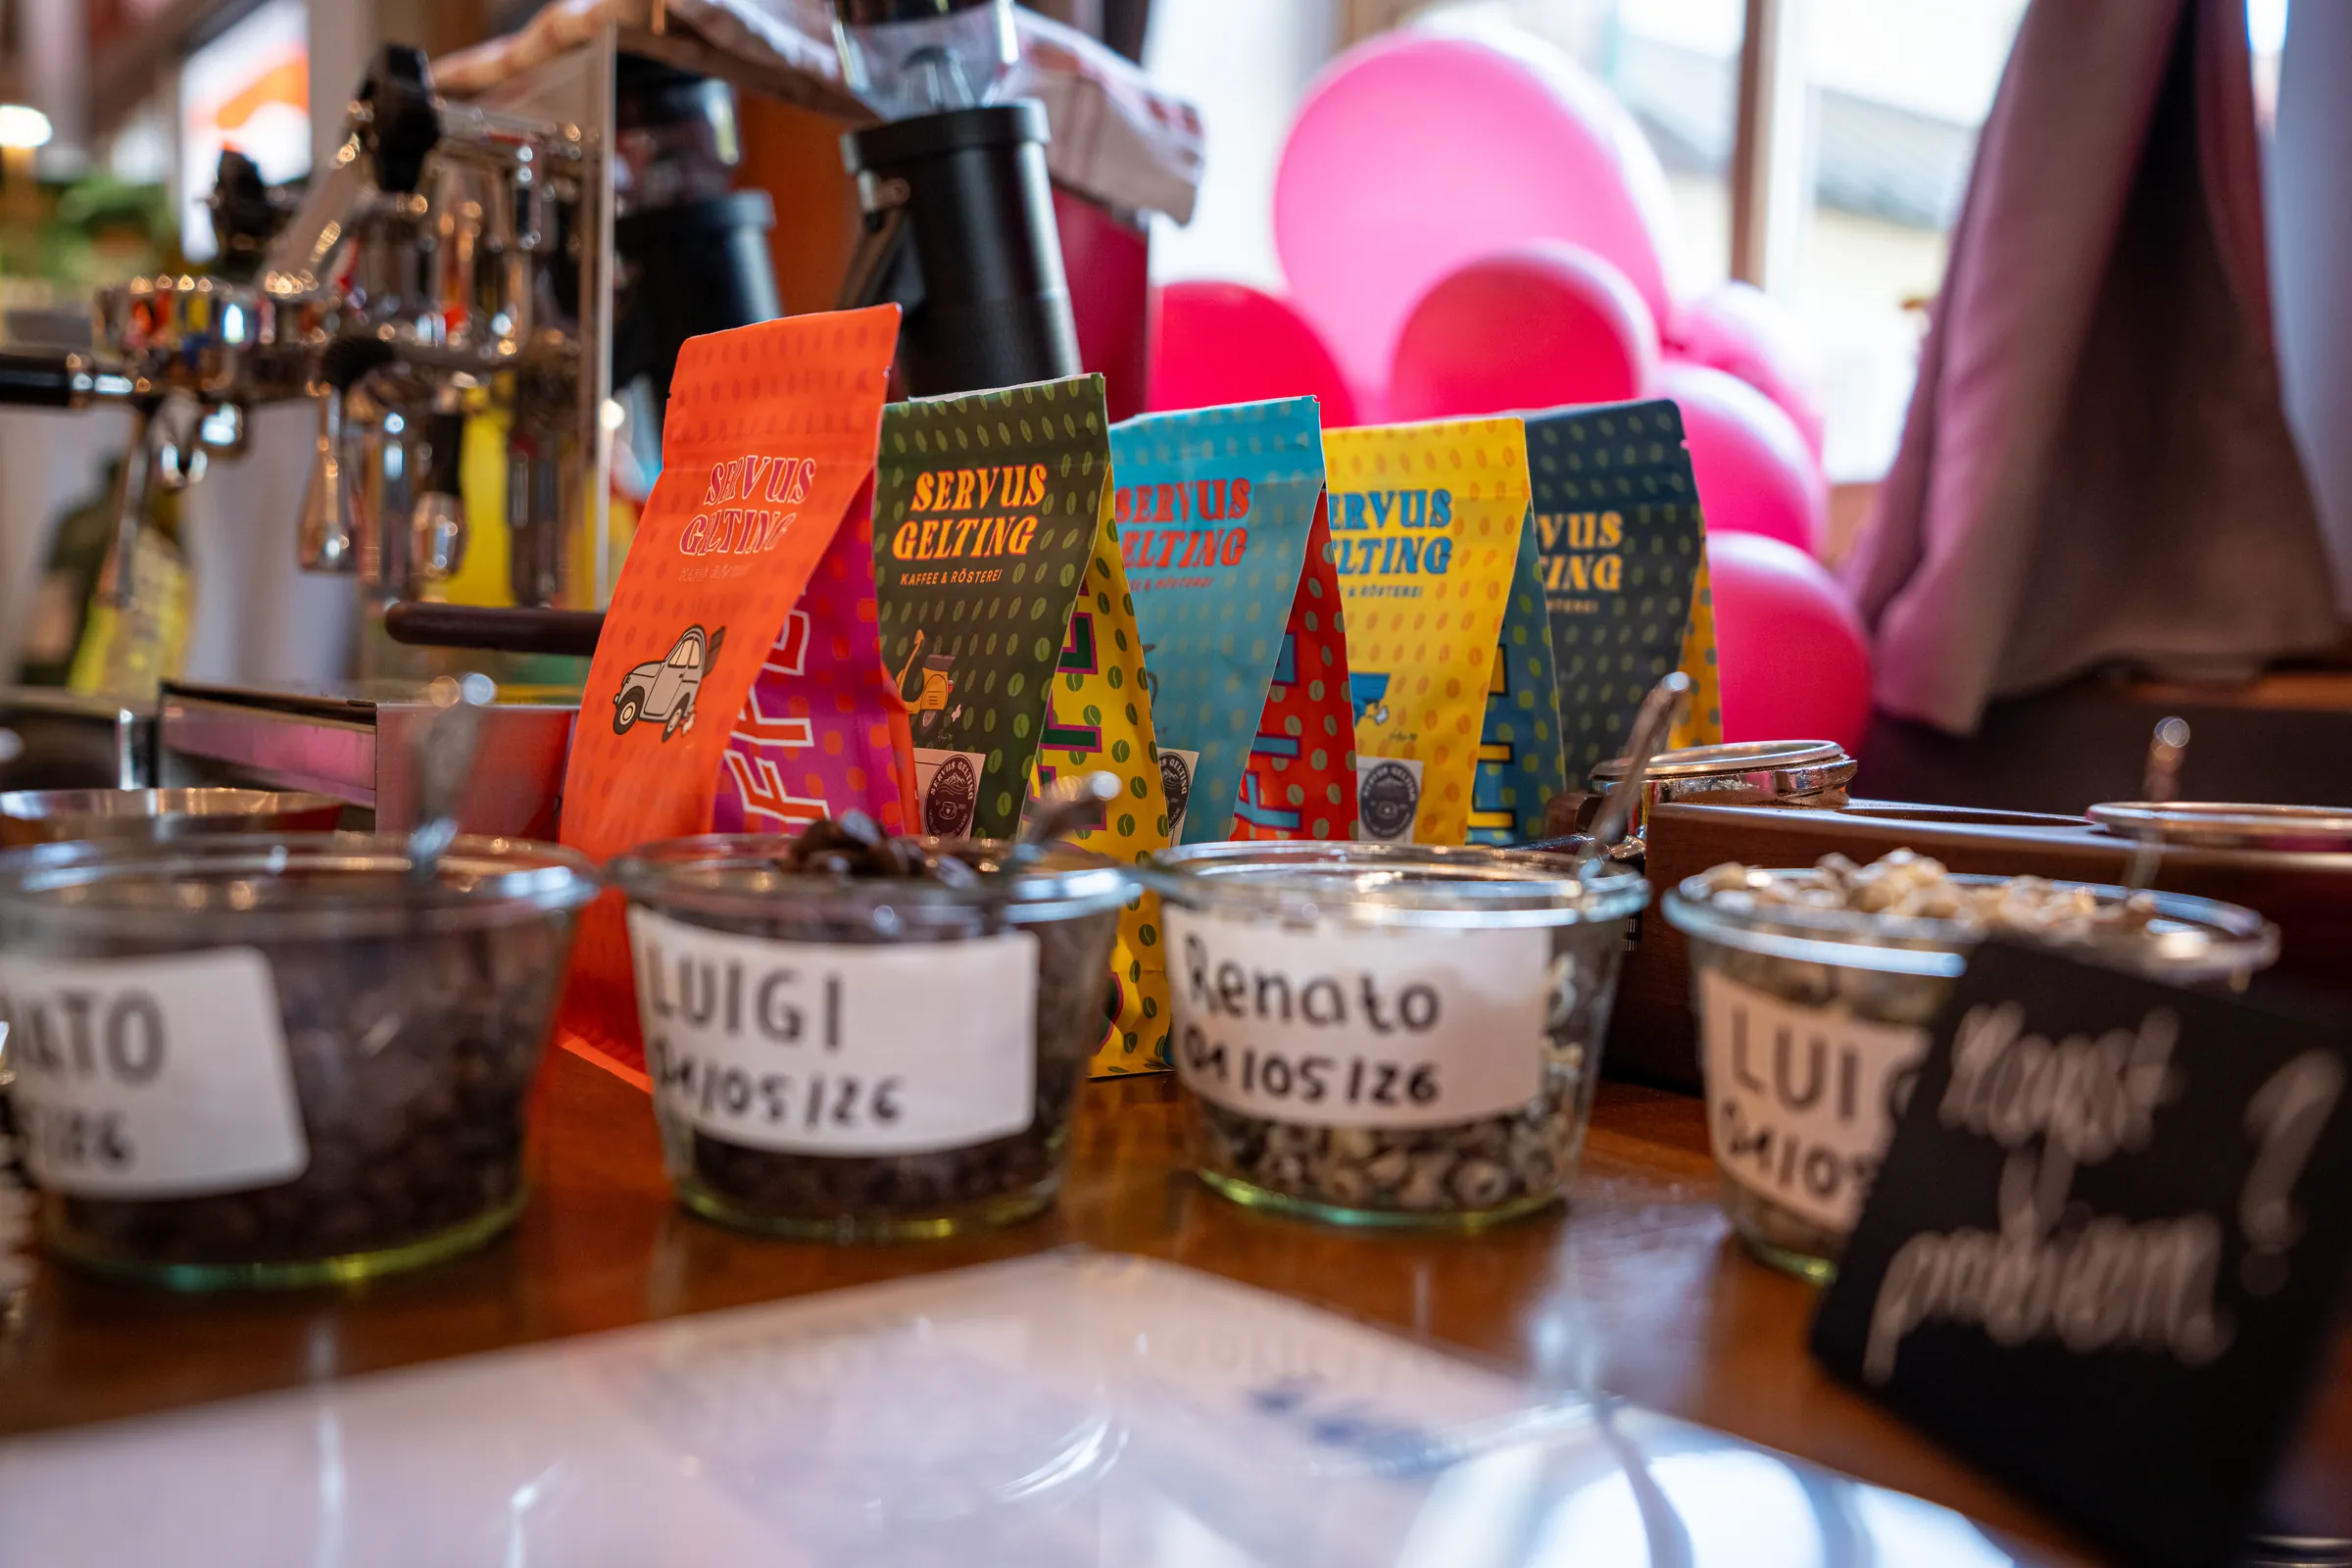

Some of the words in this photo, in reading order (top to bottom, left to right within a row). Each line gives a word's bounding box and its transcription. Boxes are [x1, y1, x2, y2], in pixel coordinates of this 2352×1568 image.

[909, 463, 1048, 512] SERVUS
[1114, 477, 1251, 523] SERVUS
[1328, 488, 1452, 531] ERVUS
[892, 514, 1039, 561] GELTING
[1122, 527, 1248, 568] ELTING
[1537, 511, 1624, 550] VUS
[901, 571, 939, 586] KAFFEE
[940, 571, 948, 584] &
[951, 567, 1003, 584] RÖSTEREI
[1332, 536, 1453, 575] LTING
[644, 943, 843, 1052] LUIGI
[1183, 932, 1442, 1032] Renato
